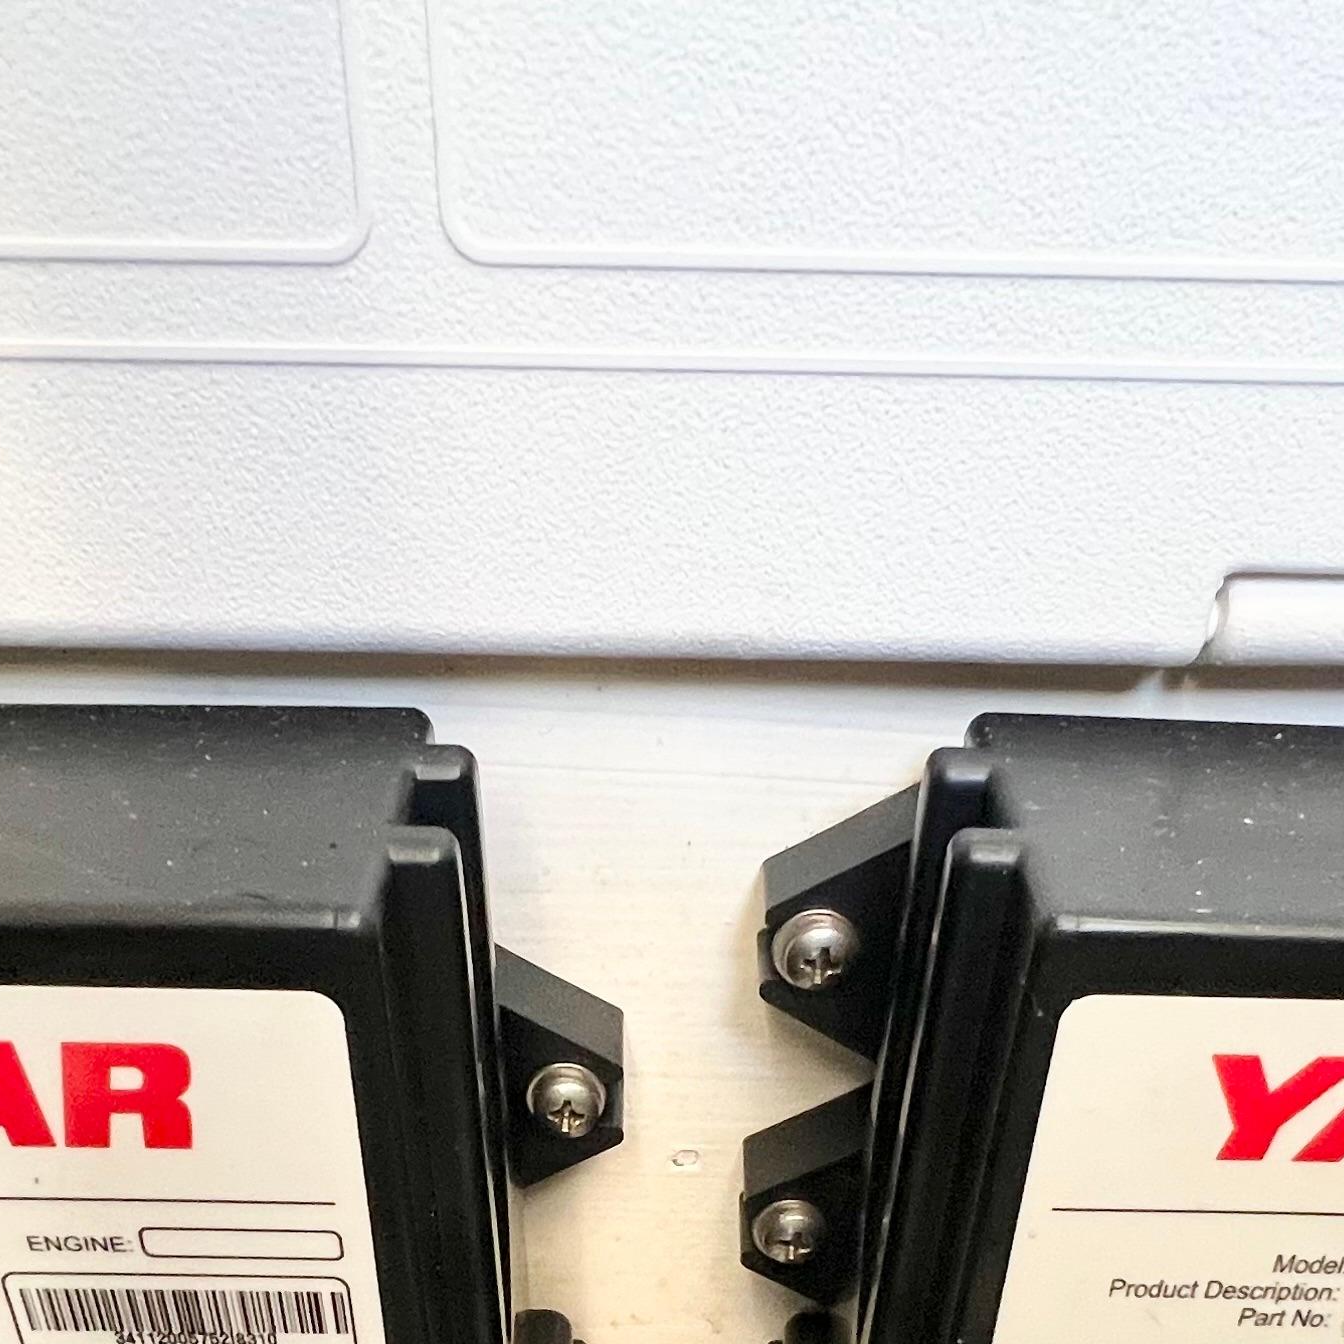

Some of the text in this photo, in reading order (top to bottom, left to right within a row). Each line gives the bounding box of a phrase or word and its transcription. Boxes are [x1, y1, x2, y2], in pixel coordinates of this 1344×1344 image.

[27, 1235, 133, 1252] ENGINE:
[1108, 1278, 1341, 1304] Product Description:
[1238, 1307, 1332, 1328] Part No:
